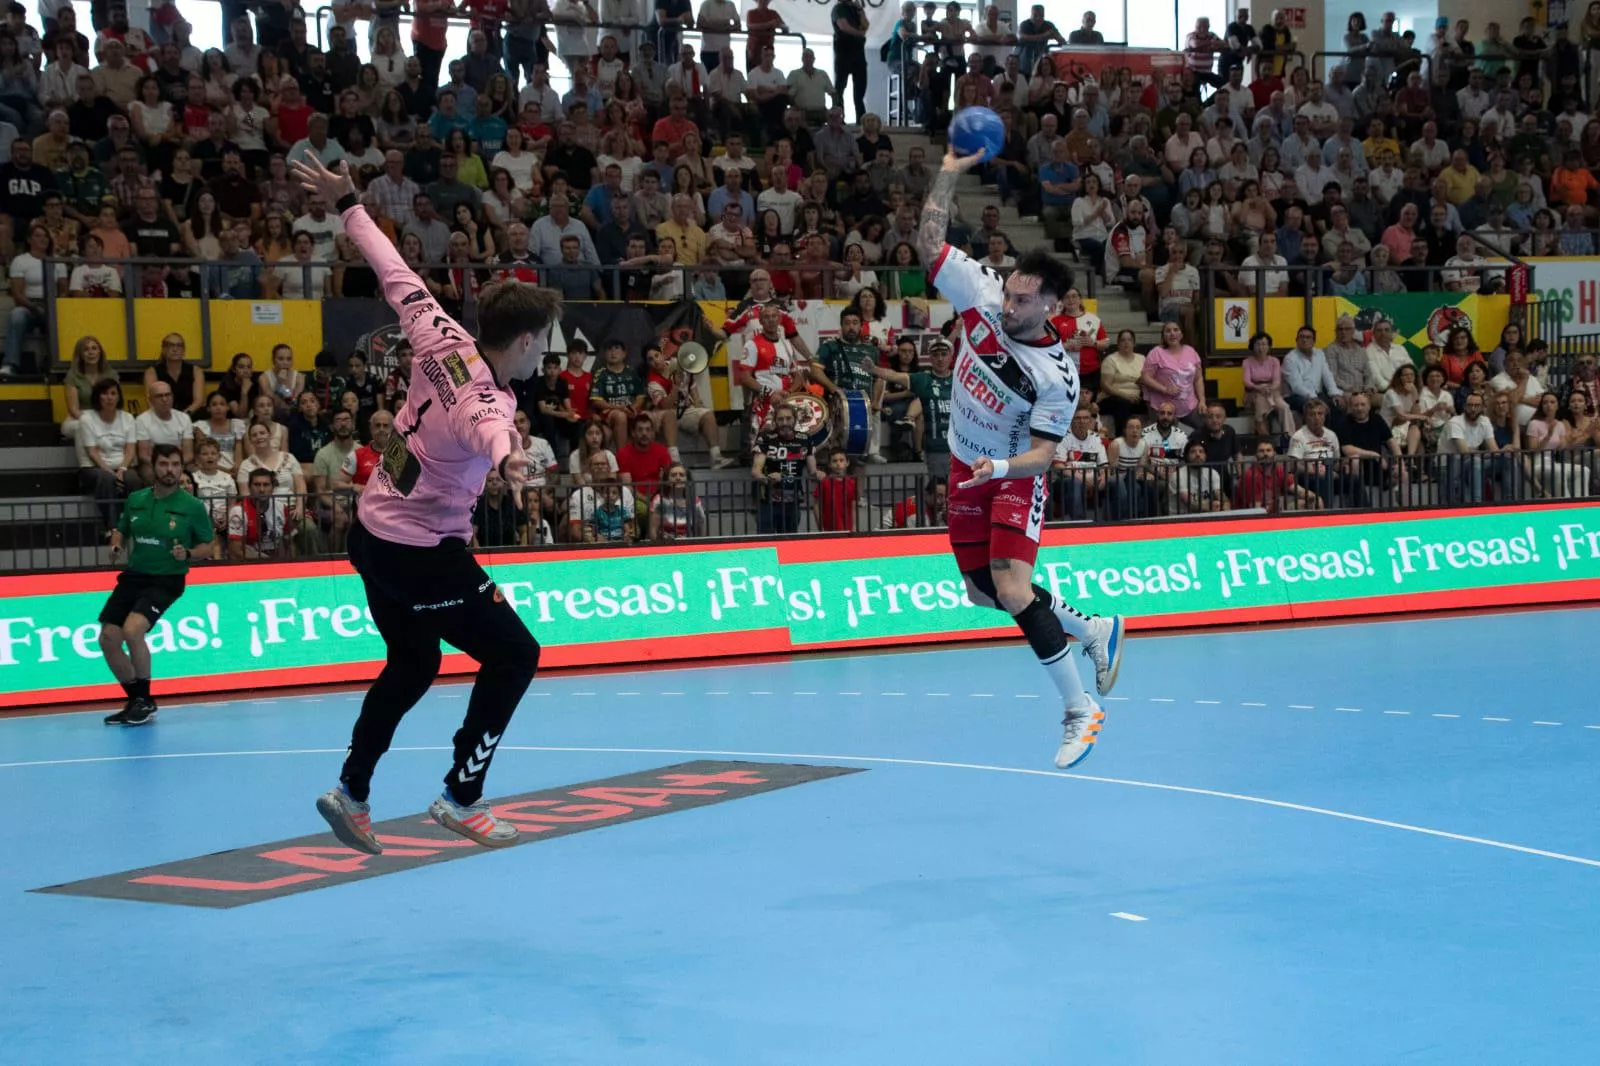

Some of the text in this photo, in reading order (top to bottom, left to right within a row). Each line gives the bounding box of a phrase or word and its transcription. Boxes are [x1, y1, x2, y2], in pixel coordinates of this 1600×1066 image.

[8, 178, 42, 196] GAP
[957, 352, 1007, 415] HEROL
[767, 446, 788, 459] 20
[1035, 552, 1202, 600] Fresas!
[1216, 539, 1375, 599] ¡Fresas!
[1387, 526, 1541, 584] ¡Fresas!
[0, 602, 222, 665] Freas!
[706, 567, 785, 621] ¡Fr
